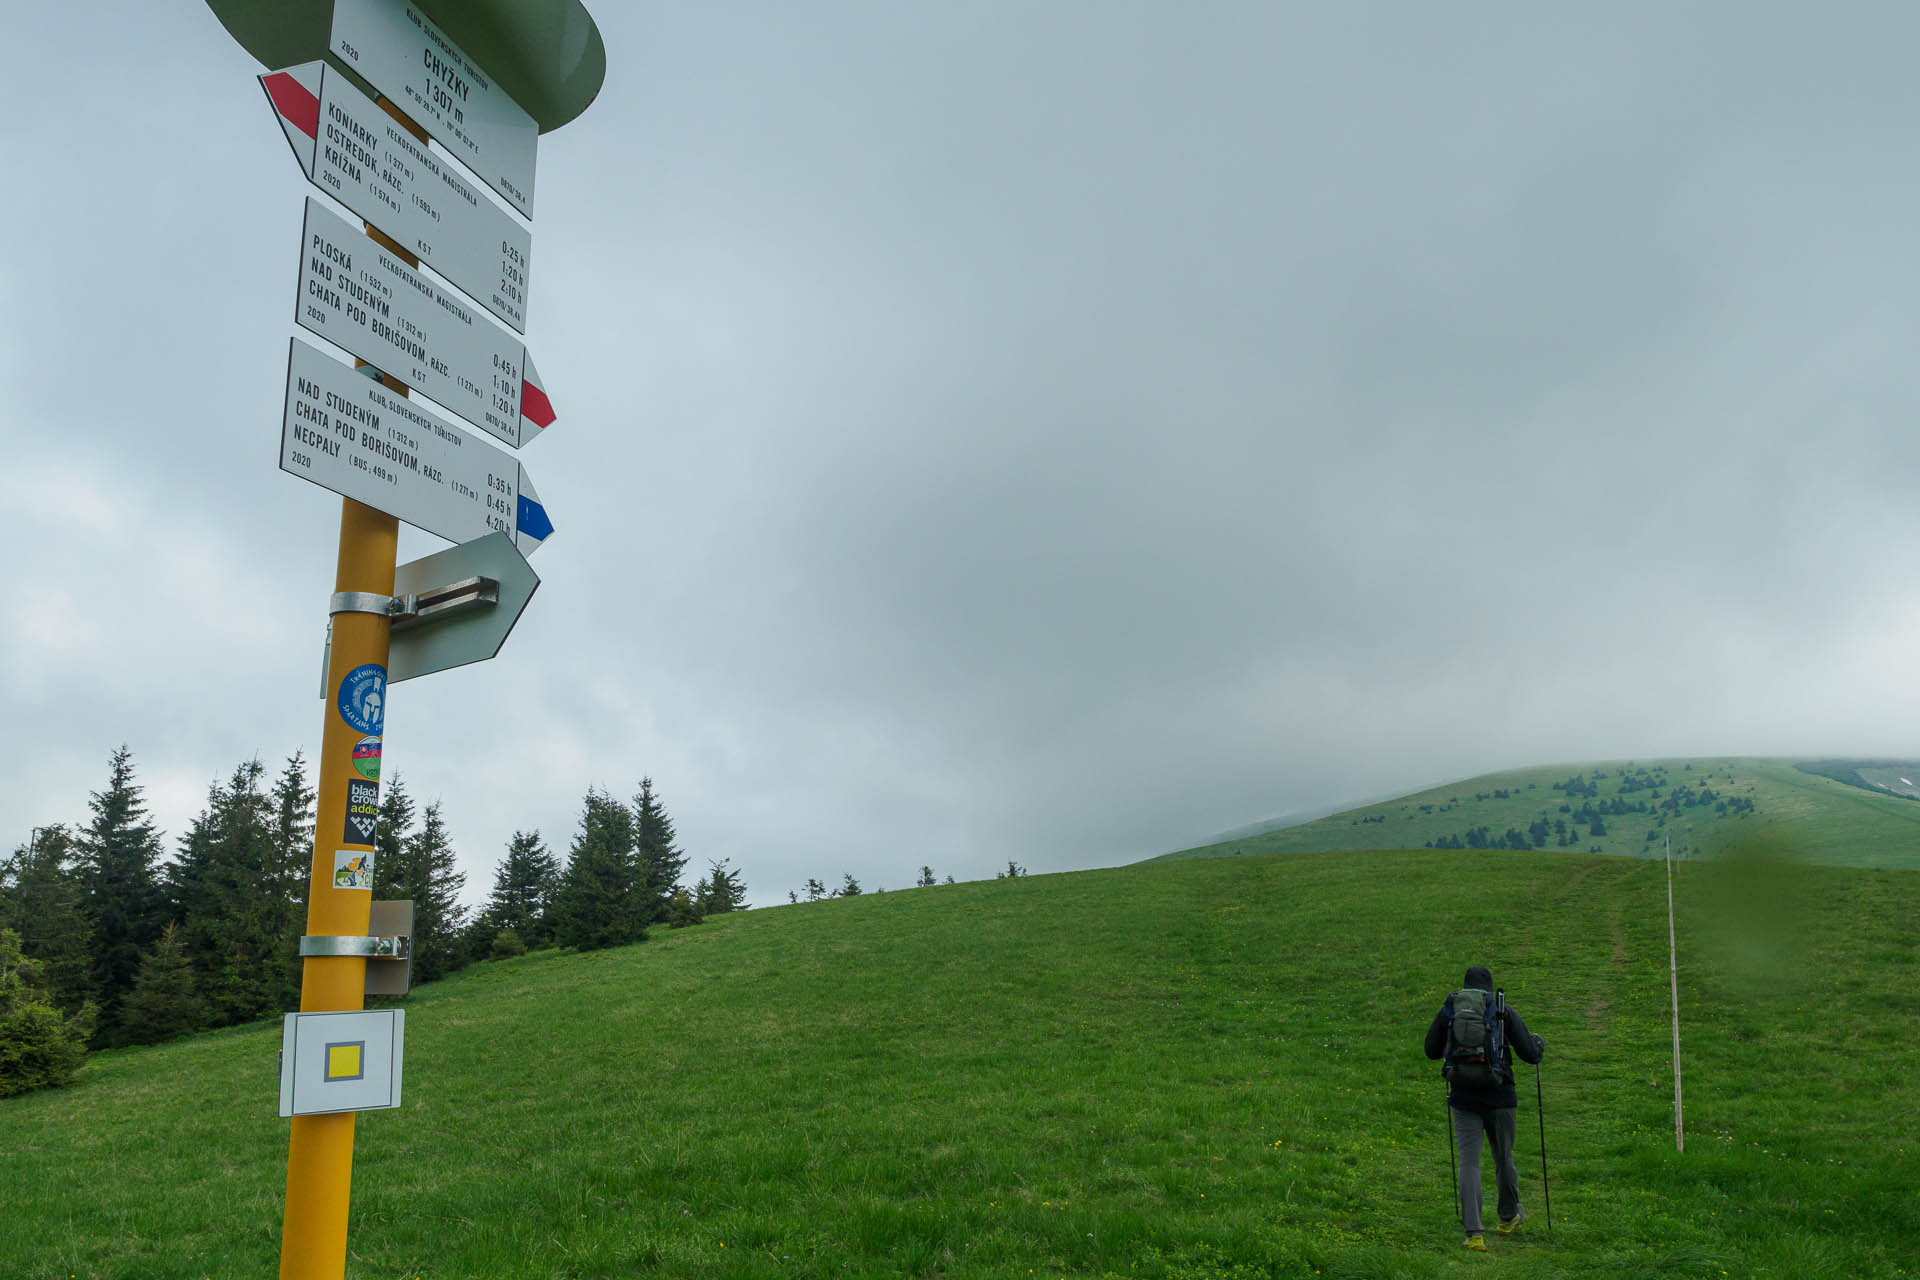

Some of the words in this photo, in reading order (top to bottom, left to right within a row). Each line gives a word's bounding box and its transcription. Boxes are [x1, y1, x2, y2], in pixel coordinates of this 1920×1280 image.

[341, 40, 359, 62] 2020
[406, 7, 422, 28] KLUB
[463, 61, 489, 91] TURISTOV
[423, 47, 469, 102] CHYŽKY
[328, 101, 378, 151] KONIARKY
[324, 144, 362, 184] KRÍŽNA
[326, 123, 380, 177] OSTREDOK,
[382, 168, 404, 195] RÁZC.
[322, 169, 341, 191] 2020
[313, 234, 352, 273] PLOSKÁ
[502, 240, 519, 264] 0:25
[519, 255, 525, 269] h
[502, 260, 518, 282] 1:20
[518, 273, 524, 287] h
[311, 256, 333, 282] NAD
[337, 273, 390, 319] STUDENÝM
[500, 278, 517, 300] 2:10
[517, 291, 522, 305] h
[307, 304, 326, 325] 2020
[309, 279, 341, 312] CHATA
[346, 301, 367, 326] POD
[371, 317, 428, 367] BORIŠOVOM,
[430, 356, 450, 379] RÁZC.
[493, 353, 511, 376] 0:45
[511, 365, 517, 380] h
[493, 374, 510, 396] 1:10
[510, 385, 516, 399] h
[297, 376, 320, 401] NAD
[325, 391, 380, 431] STUDENÝM
[492, 393, 509, 414] 1:20
[509, 404, 515, 418] h
[293, 423, 341, 458] NECPALY
[295, 400, 329, 430] CHATA
[335, 418, 356, 442] POD
[361, 431, 421, 475] BORIŠOVOM,
[423, 464, 444, 485] RÁZC.
[291, 450, 312, 469] 2020
[487, 473, 506, 494] 0:35
[506, 482, 512, 497] h
[486, 493, 505, 514] 0:45
[506, 503, 511, 518] h
[485, 514, 505, 534] 4:20
[342, 704, 371, 730] SPARTANS
[351, 783, 378, 797] black
